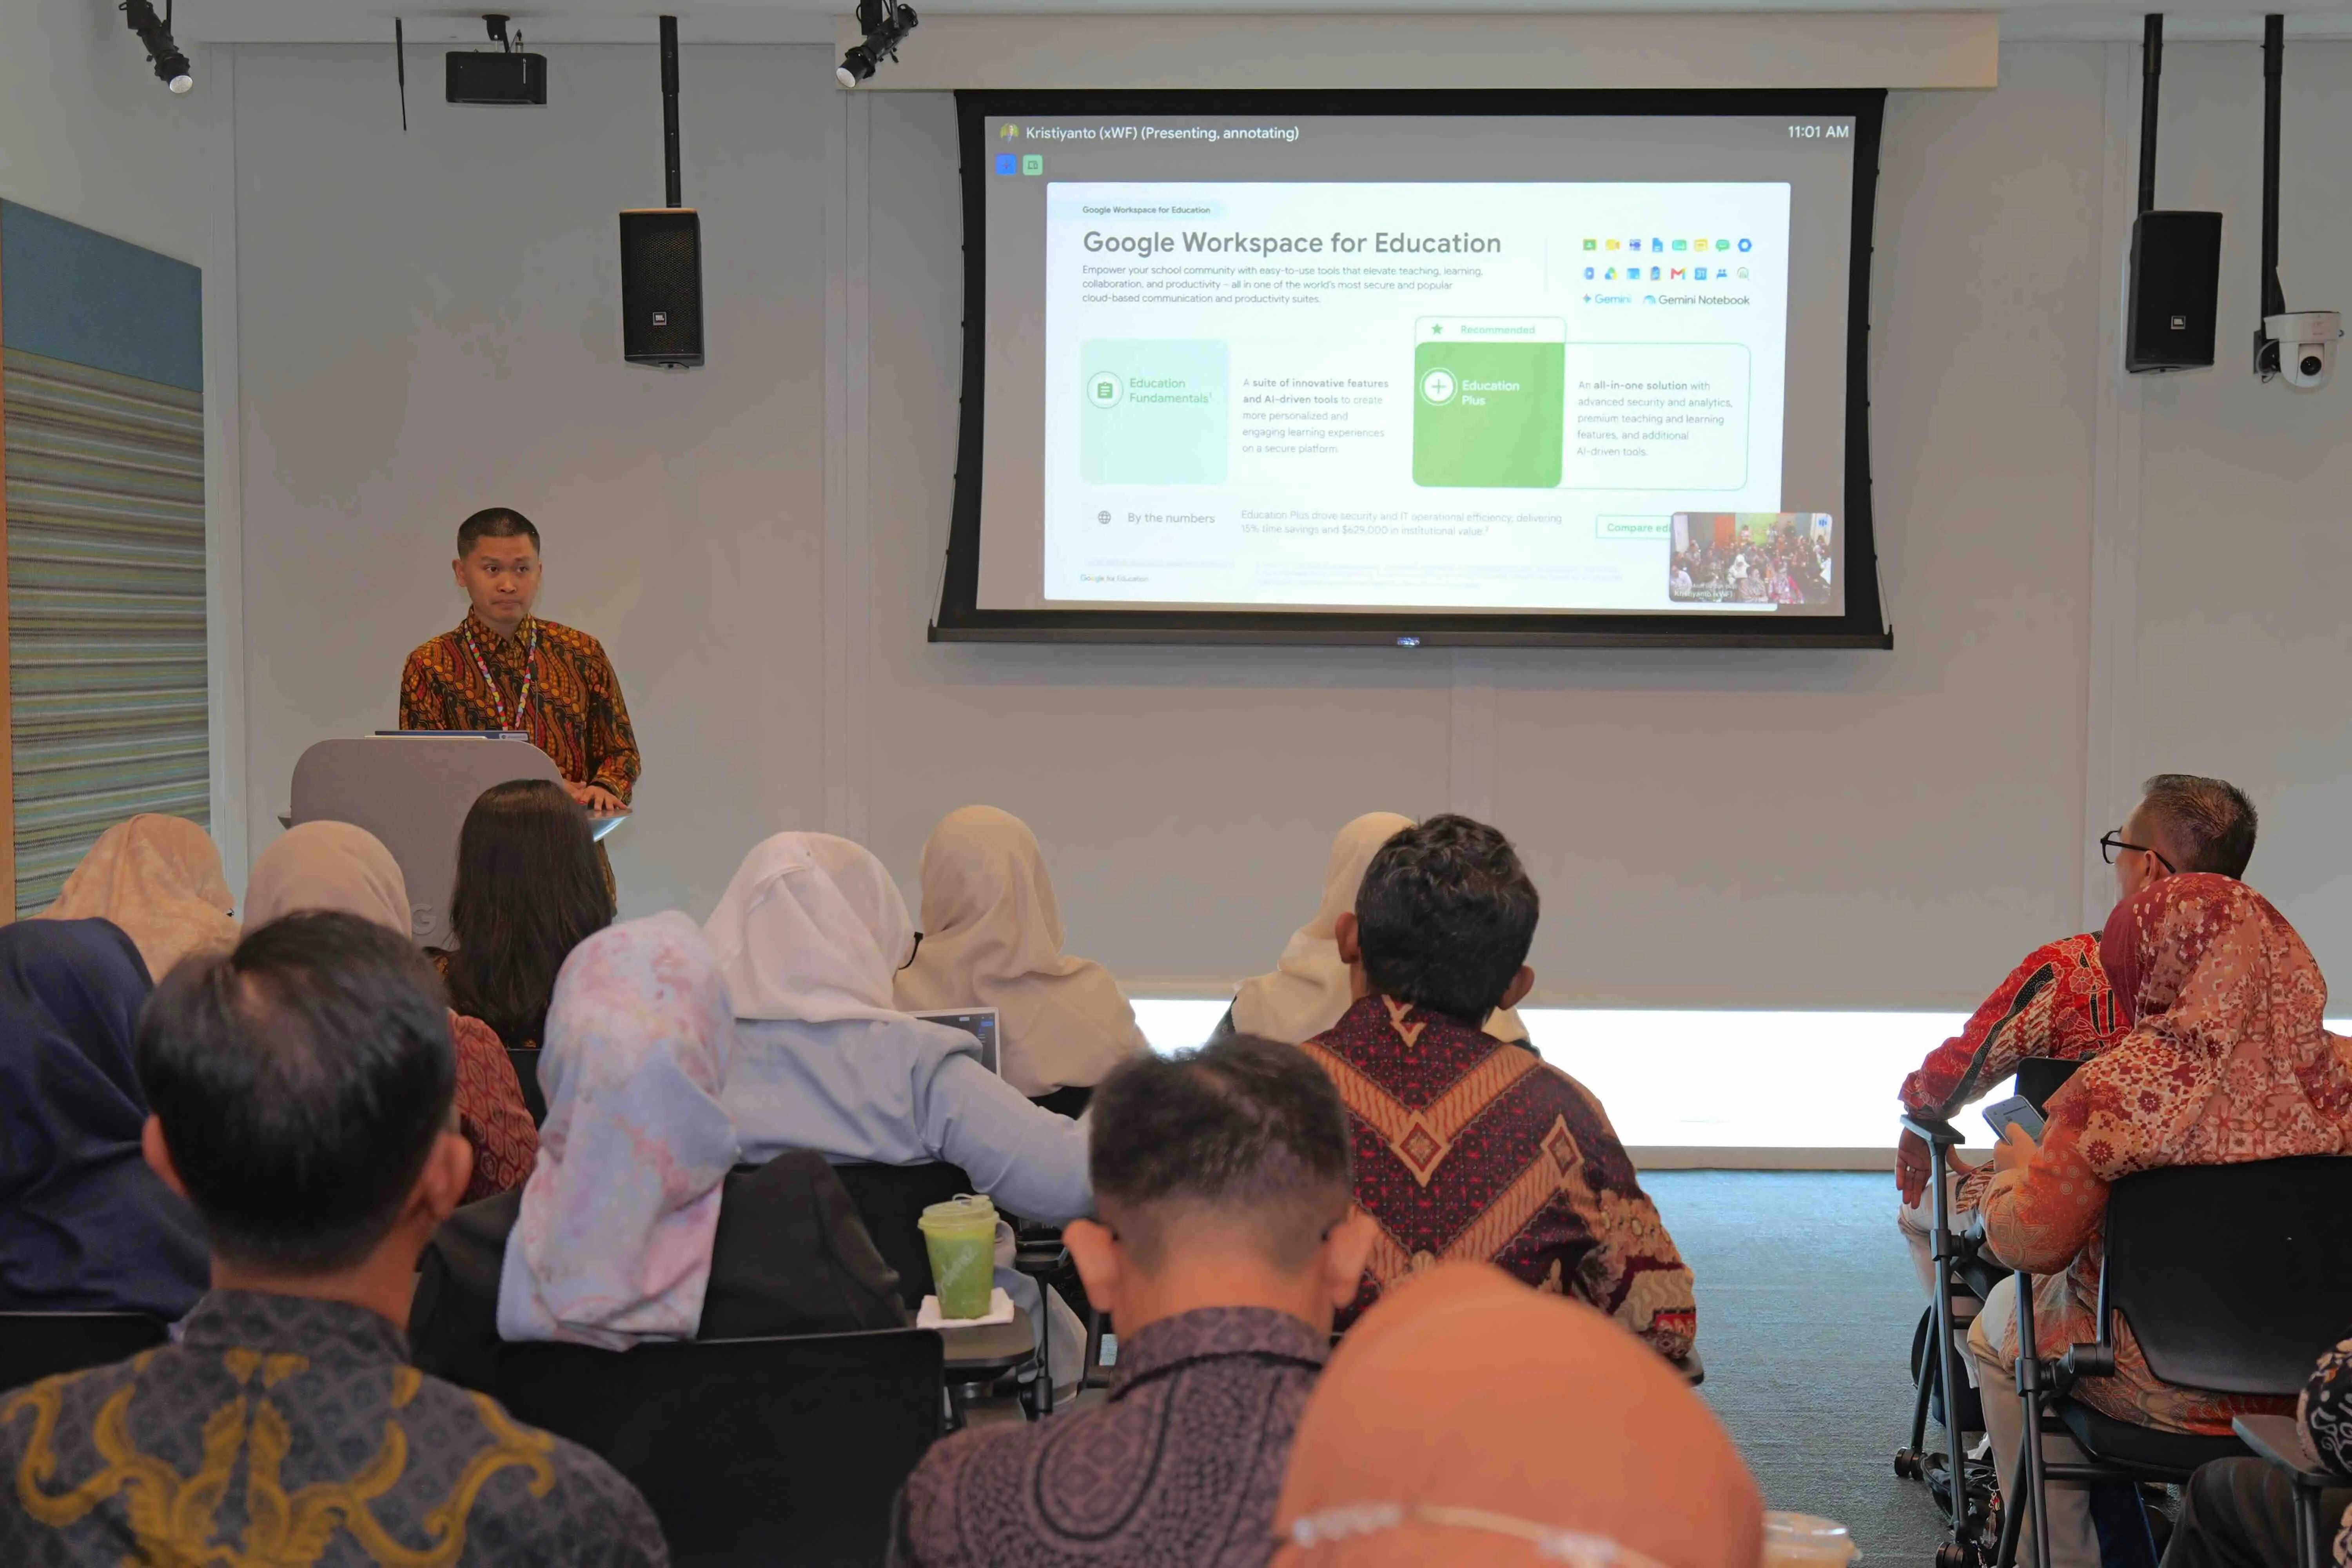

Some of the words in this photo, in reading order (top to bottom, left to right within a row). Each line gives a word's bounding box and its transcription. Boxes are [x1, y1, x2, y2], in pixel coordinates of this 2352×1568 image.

[1027, 127, 1096, 142] Kristiyanto
[1100, 127, 1137, 140] (xWF)
[1223, 126, 1299, 142] annotating)
[1789, 126, 1820, 138] 11:01
[1826, 125, 1849, 138] AM
[1082, 206, 1111, 215] Google
[1113, 206, 1156, 215] Workspace
[1084, 231, 1174, 258] Google
[1182, 232, 1323, 258] Workspace
[1331, 232, 1367, 253] for
[1376, 232, 1500, 253] Education
[1083, 265, 1126, 276] Empower
[1129, 267, 1149, 276] your
[1151, 266, 1181, 274] school
[1183, 266, 1235, 276] community
[1238, 266, 1257, 274] with
[1259, 267, 1315, 276] easy-to-use
[1318, 267, 1340, 275] tools
[1343, 267, 1361, 275] that
[1363, 267, 1397, 275] elevate
[1146, 280, 1163, 288] and
[1166, 279, 1220, 290] productivity
[1232, 279, 1241, 289] all
[1243, 280, 1251, 289] in
[1274, 280, 1283, 289] of
[1286, 280, 1301, 289] the
[1417, 281, 1452, 292] popular
[1082, 293, 1140, 302] cloud-based
[1142, 294, 1213, 303] communication
[1235, 294, 1290, 305] productivity
[1595, 294, 1631, 304] Gemini
[1659, 295, 1695, 305] Gemini
[1699, 295, 1749, 305] Notebook
[1461, 325, 1535, 334] Recommended
[1130, 378, 1185, 388] Education
[1253, 378, 1276, 387] suite
[1280, 379, 1289, 387] of
[1292, 379, 1344, 387] innovative
[1348, 379, 1388, 387] features
[1463, 380, 1520, 391] Education
[1594, 380, 1643, 390] all-in-one
[1647, 380, 1687, 390] solution
[1691, 381, 1710, 390] with
[1243, 394, 1261, 403] and
[1264, 394, 1311, 403] AI-driven
[1314, 395, 1338, 403] tools
[1462, 395, 1486, 405] Plus
[1577, 397, 1624, 406] advanced
[1627, 399, 1664, 408] security
[1668, 398, 1686, 407] and
[1269, 411, 1328, 423] personalized
[1331, 412, 1348, 421] and
[1578, 414, 1618, 424] premium
[1622, 414, 1663, 425] teaching
[1666, 415, 1683, 423] and
[1686, 414, 1724, 426] learning
[1243, 428, 1285, 439] engaging
[1288, 427, 1325, 439] learning
[1328, 429, 1384, 439] experiences
[1622, 431, 1639, 439] and
[1642, 431, 1689, 440] additional
[1577, 447, 1620, 456] AI-driven
[1128, 512, 1142, 524] By
[1145, 513, 1163, 523] the
[1166, 514, 1215, 523] numbers
[1607, 523, 1653, 534] Compare
[412, 903, 437, 935] G
